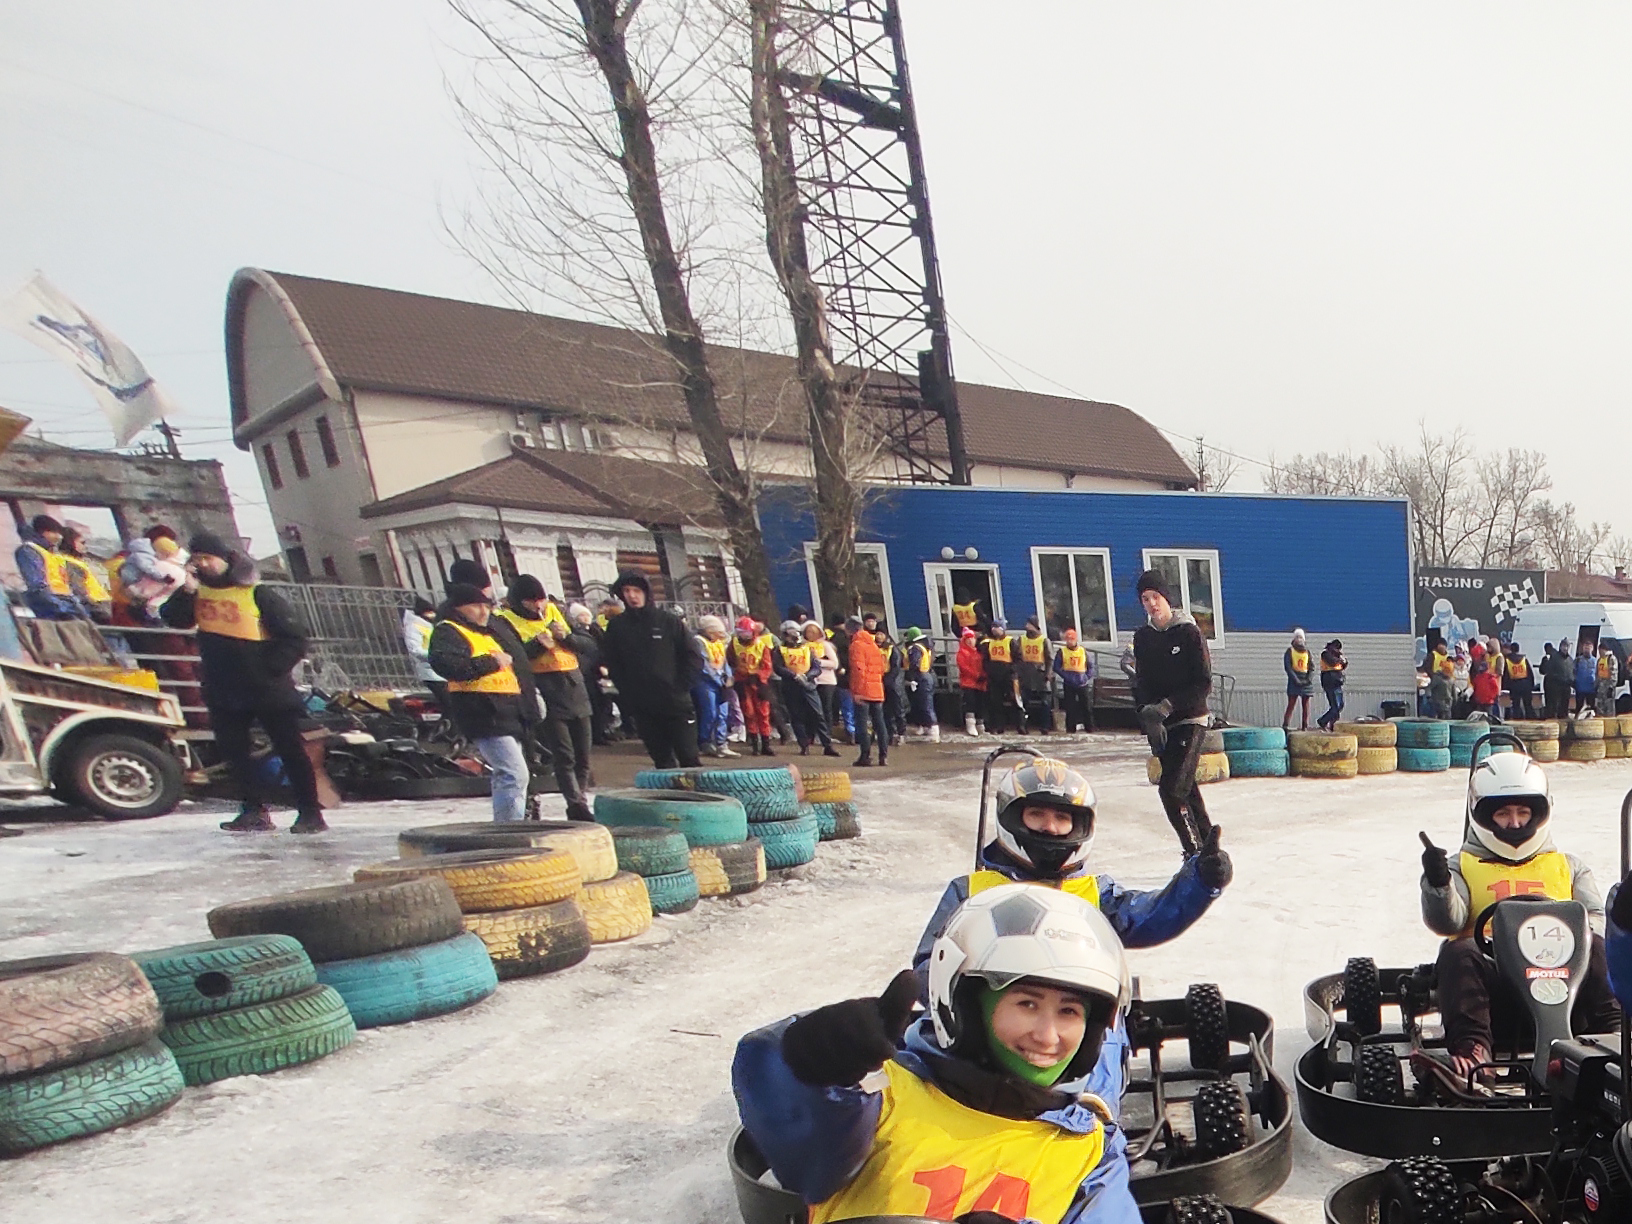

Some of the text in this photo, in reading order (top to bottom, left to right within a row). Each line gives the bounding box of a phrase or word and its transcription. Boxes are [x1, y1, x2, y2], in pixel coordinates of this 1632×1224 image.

[1418, 576, 1484, 589] RASING
[1526, 926, 1566, 942] 14
[1528, 969, 1569, 979] MOTUL
